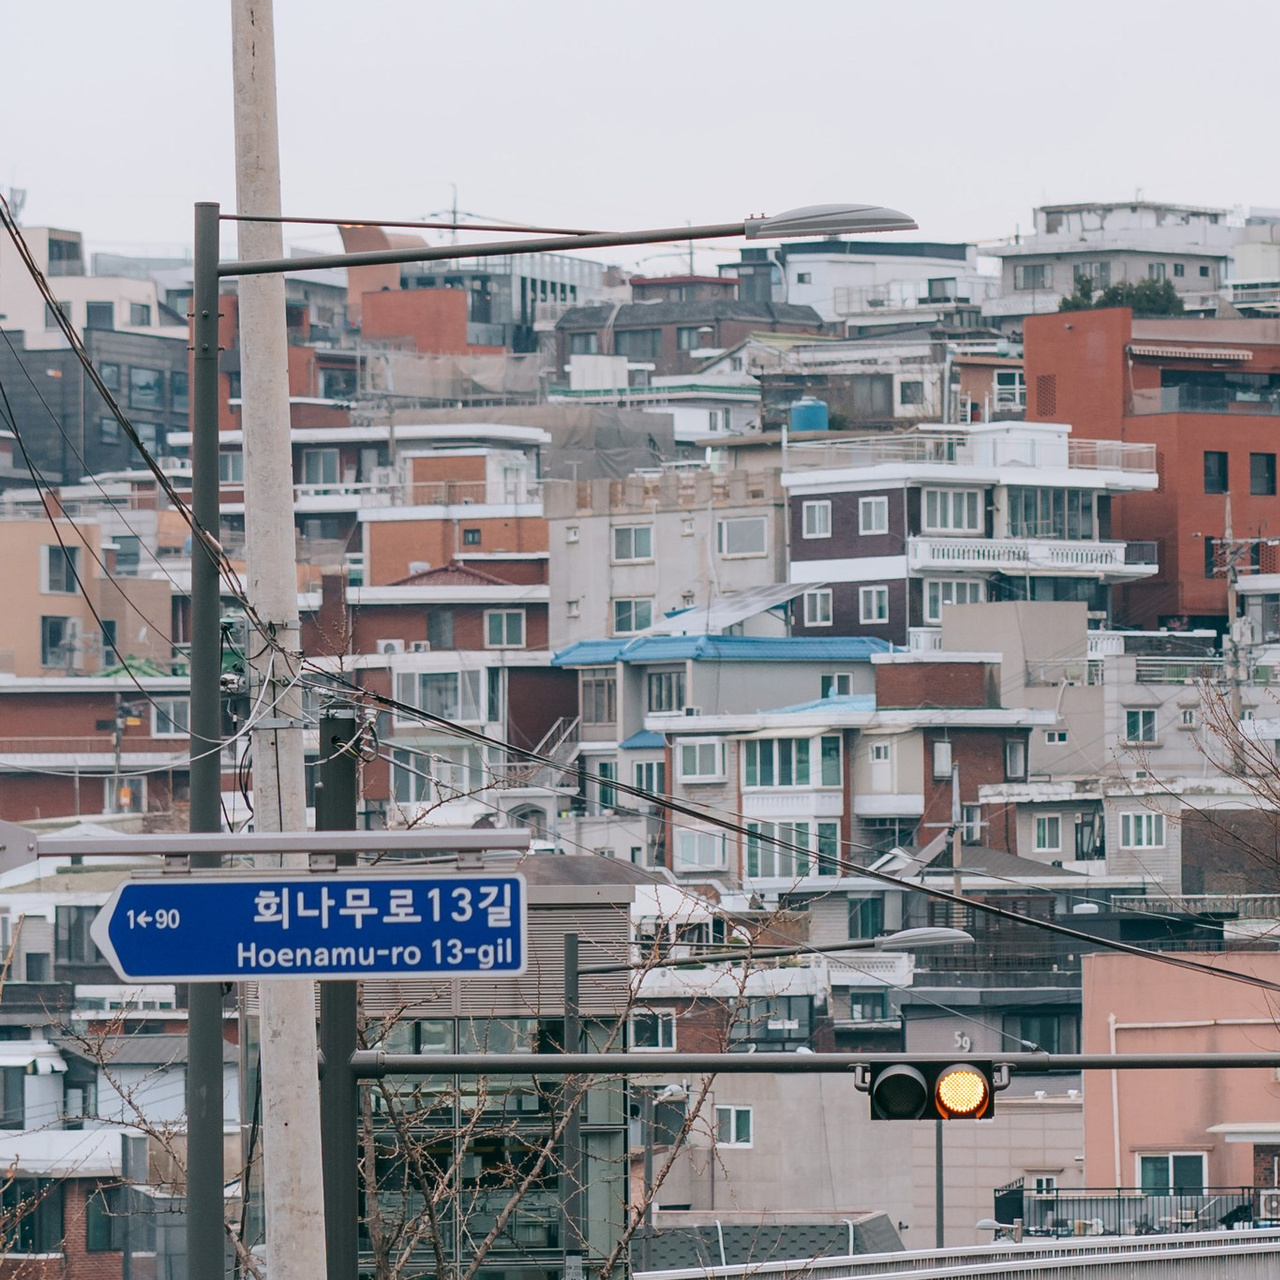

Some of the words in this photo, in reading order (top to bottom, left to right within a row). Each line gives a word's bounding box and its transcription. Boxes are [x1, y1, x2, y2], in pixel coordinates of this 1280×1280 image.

[253, 883, 512, 930] 회나무로13길
[238, 942, 421, 968] Hoenamu-ro
[432, 938, 513, 970] 13-gil
[954, 1031, 971, 1053] 59
